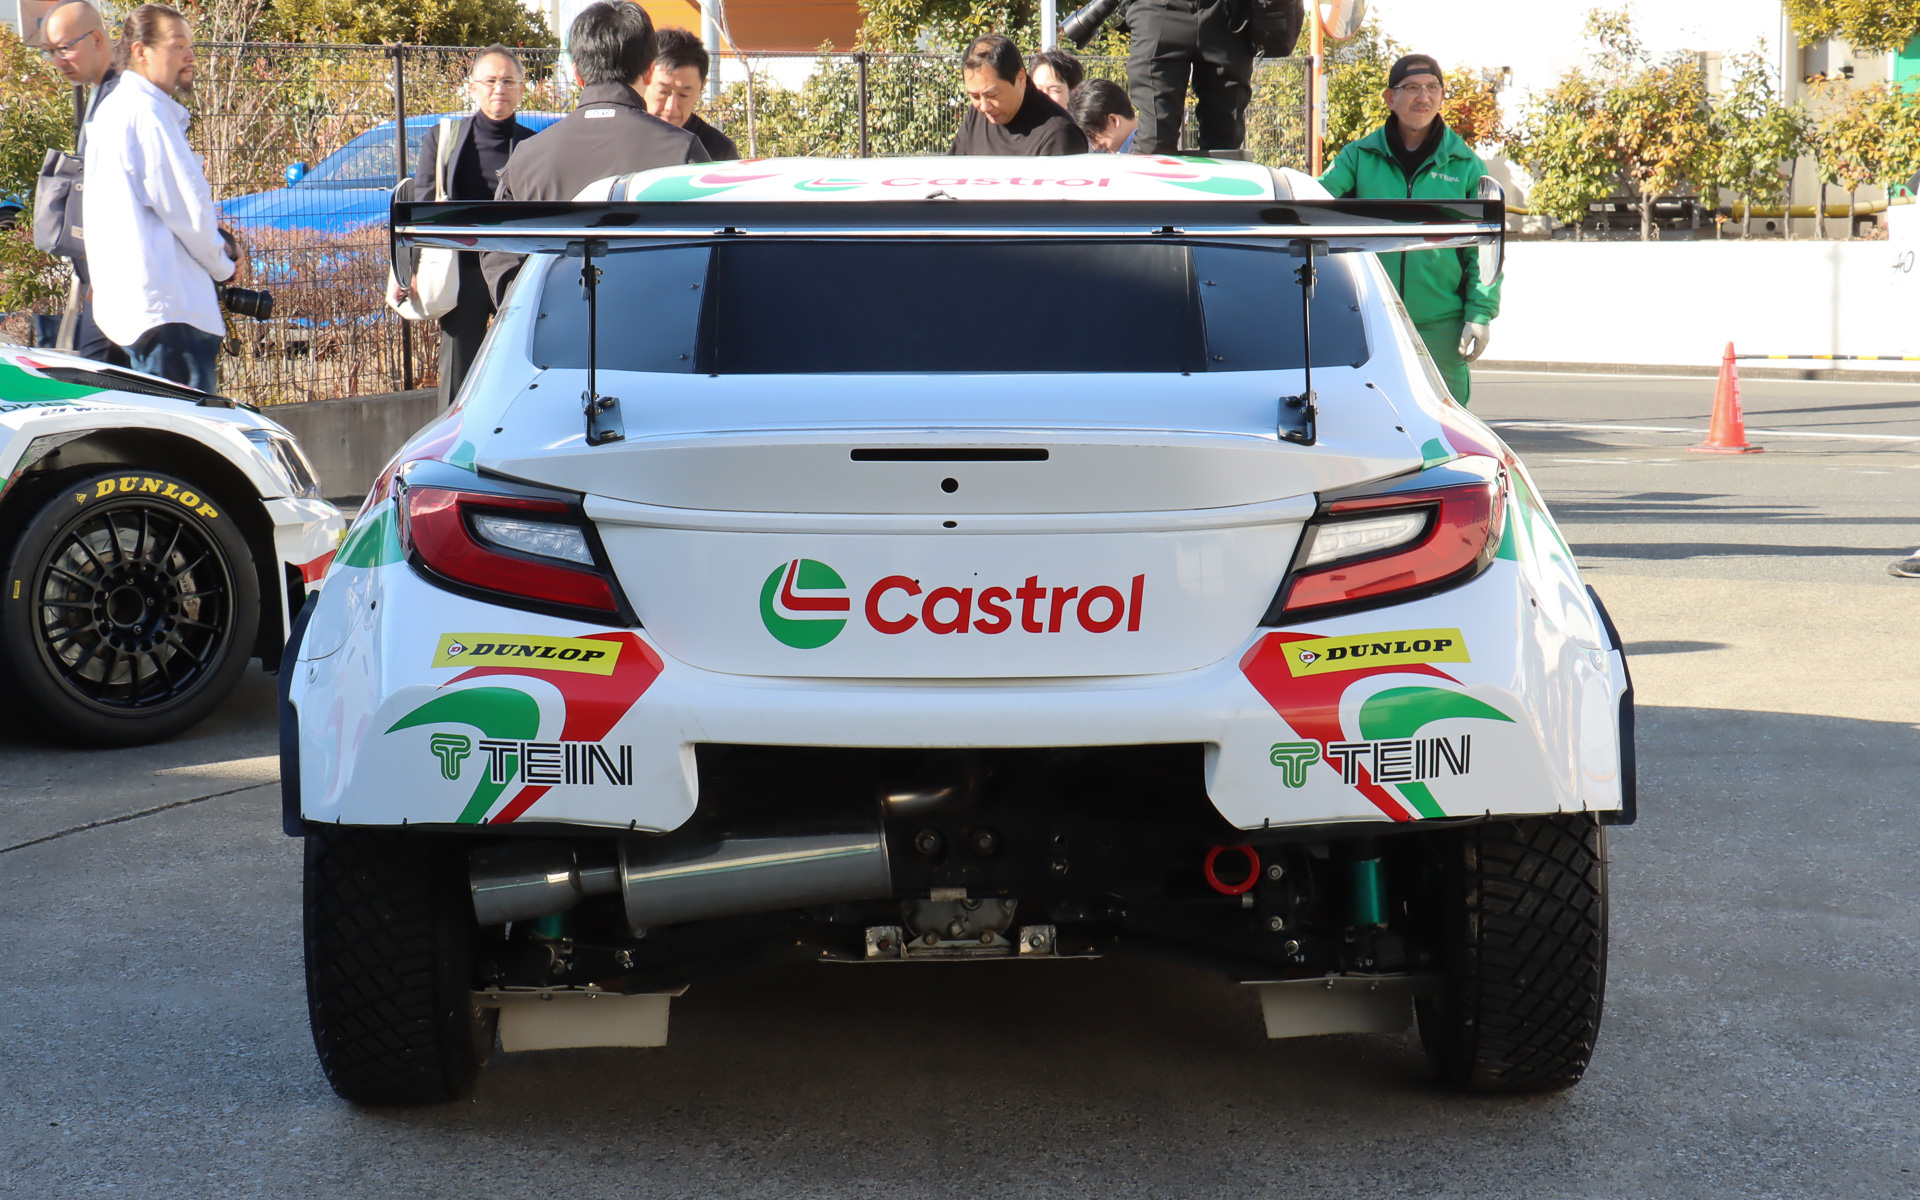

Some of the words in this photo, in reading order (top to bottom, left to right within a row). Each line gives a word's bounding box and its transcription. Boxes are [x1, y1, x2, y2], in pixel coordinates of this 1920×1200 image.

[880, 176, 1110, 188] Castrol
[95, 476, 219, 519] DUNLOP
[865, 573, 1145, 635] Castrol
[468, 643, 606, 662] DUNLOP
[1325, 638, 1453, 662] DUNLOP
[478, 739, 633, 786] TEIN
[1328, 733, 1472, 785] TEIN
